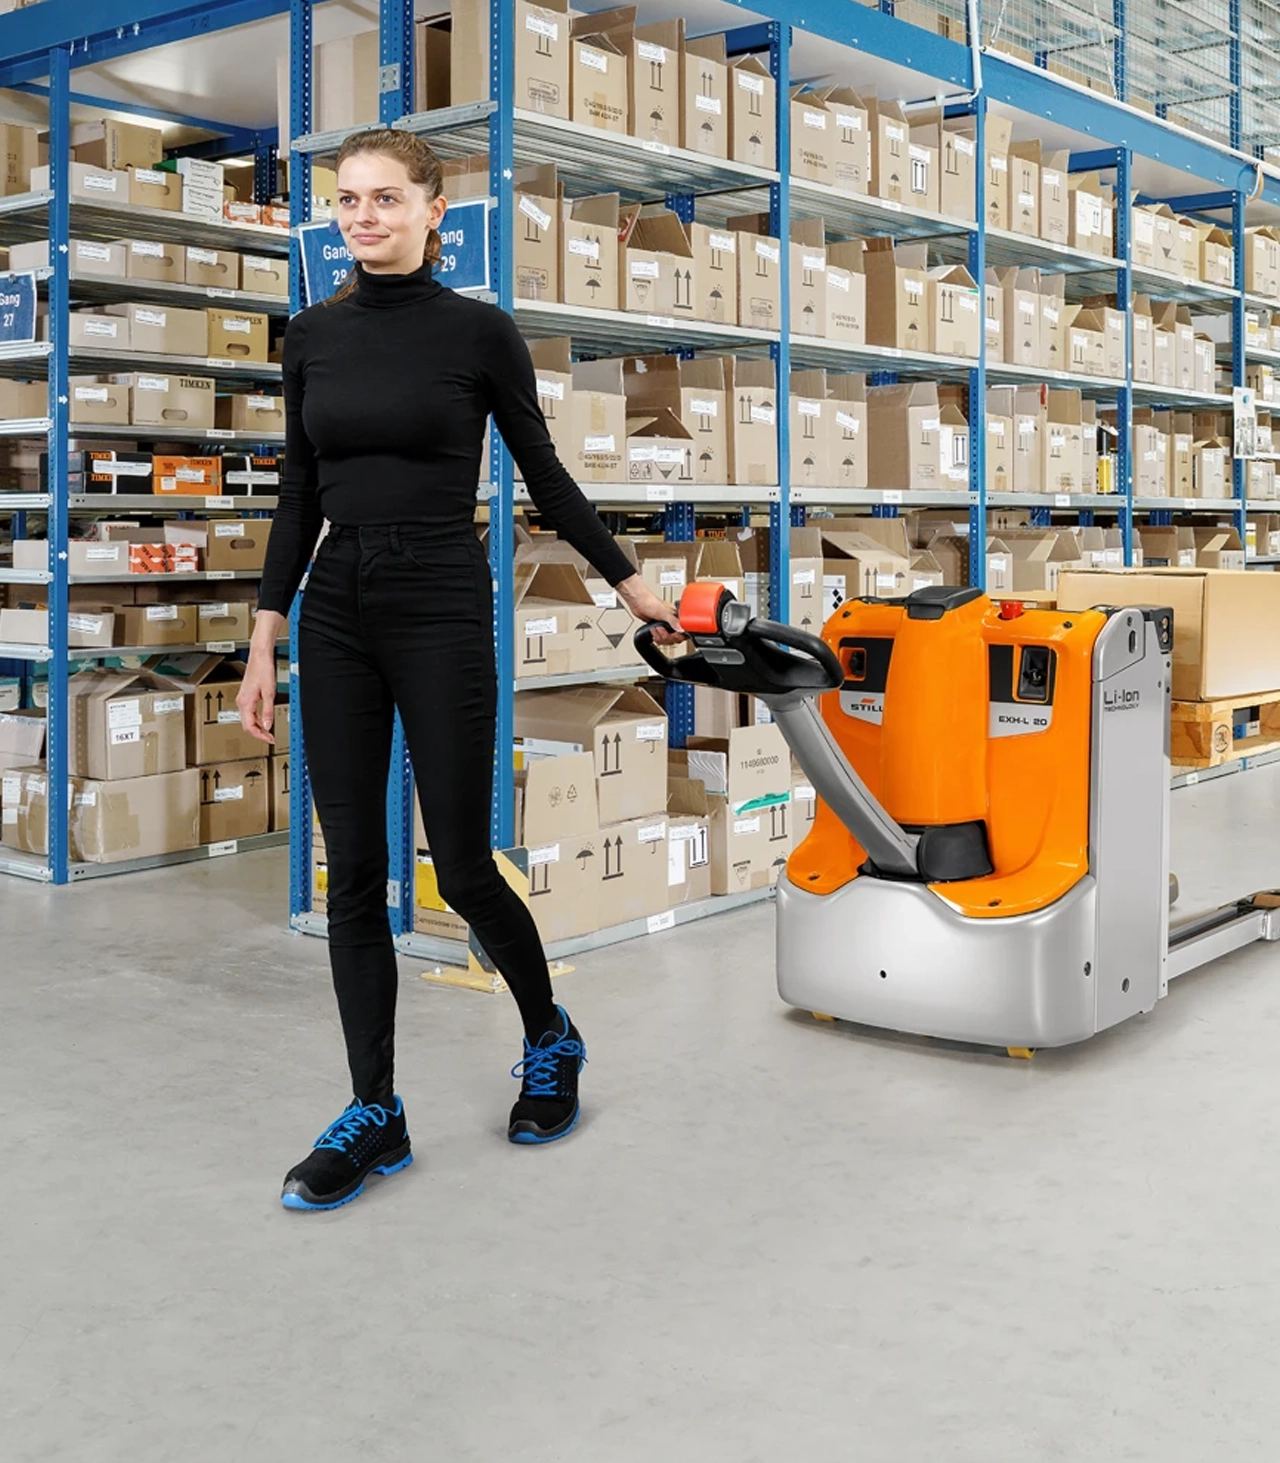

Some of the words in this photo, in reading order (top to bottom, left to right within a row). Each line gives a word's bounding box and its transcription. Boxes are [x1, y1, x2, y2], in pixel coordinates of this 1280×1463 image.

[440, 229, 463, 247] ang
[440, 254, 456, 272] 29
[0, 292, 20, 308] Gang
[3, 313, 14, 327] 27
[179, 378, 212, 390] TIMKEN
[1103, 689, 1140, 704] Li-Ion
[850, 703, 883, 712] STILL
[998, 715, 1029, 725] EXH-L
[1033, 718, 1048, 726] 20
